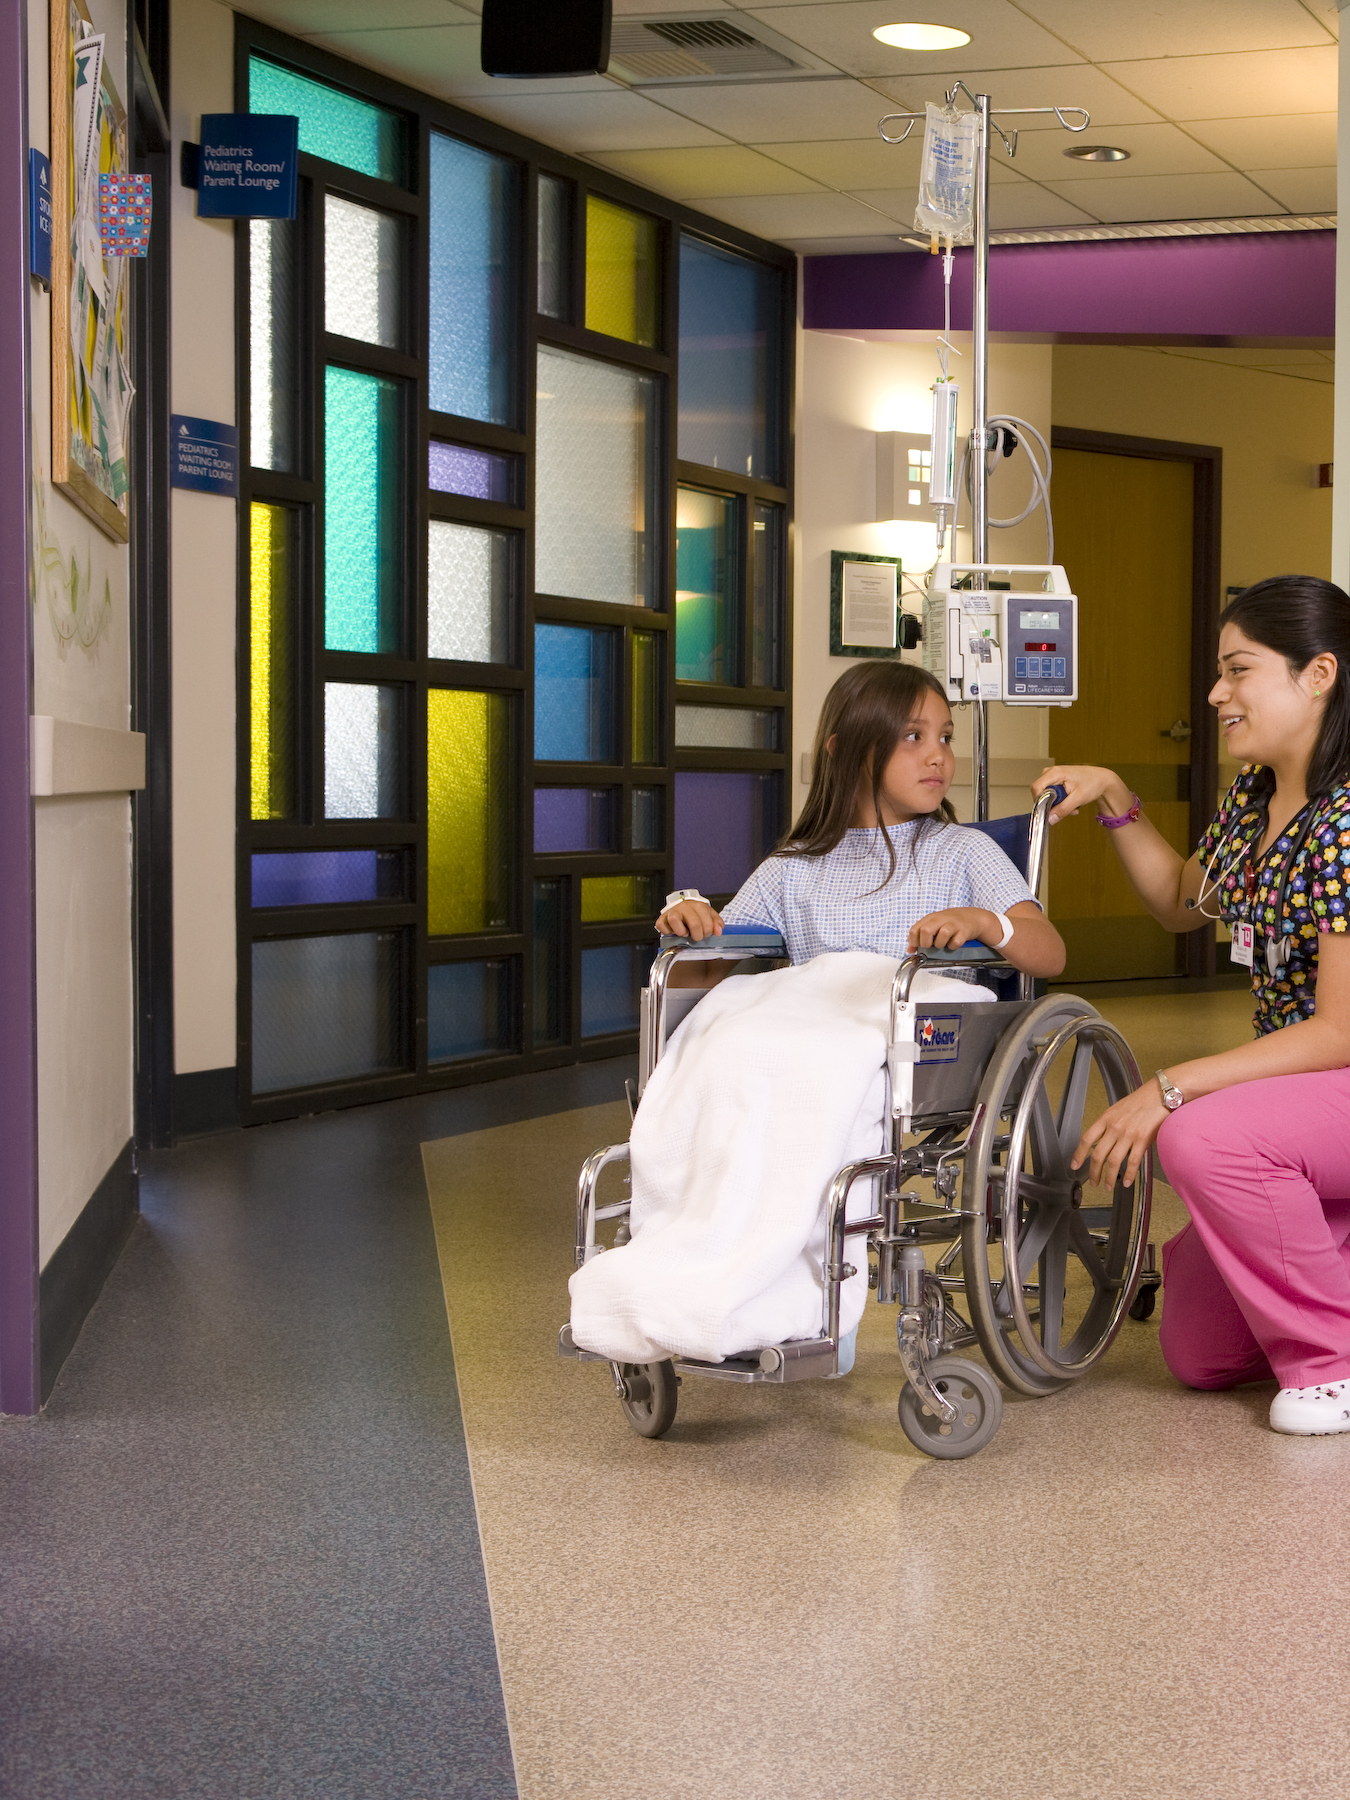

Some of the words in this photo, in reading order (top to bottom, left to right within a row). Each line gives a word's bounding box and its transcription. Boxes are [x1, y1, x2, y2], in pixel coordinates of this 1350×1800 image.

[204, 145, 254, 157] Pediatrics
[204, 160, 242, 174] Waiting
[245, 160, 285, 173] Room/
[203, 175, 236, 187] Parent
[238, 175, 280, 190] Lounge
[178, 443, 218, 457] PEDIATRICS
[178, 453, 212, 467] WAITING
[178, 464, 208, 476] PARENT
[208, 468, 234, 481] LOUNGE
